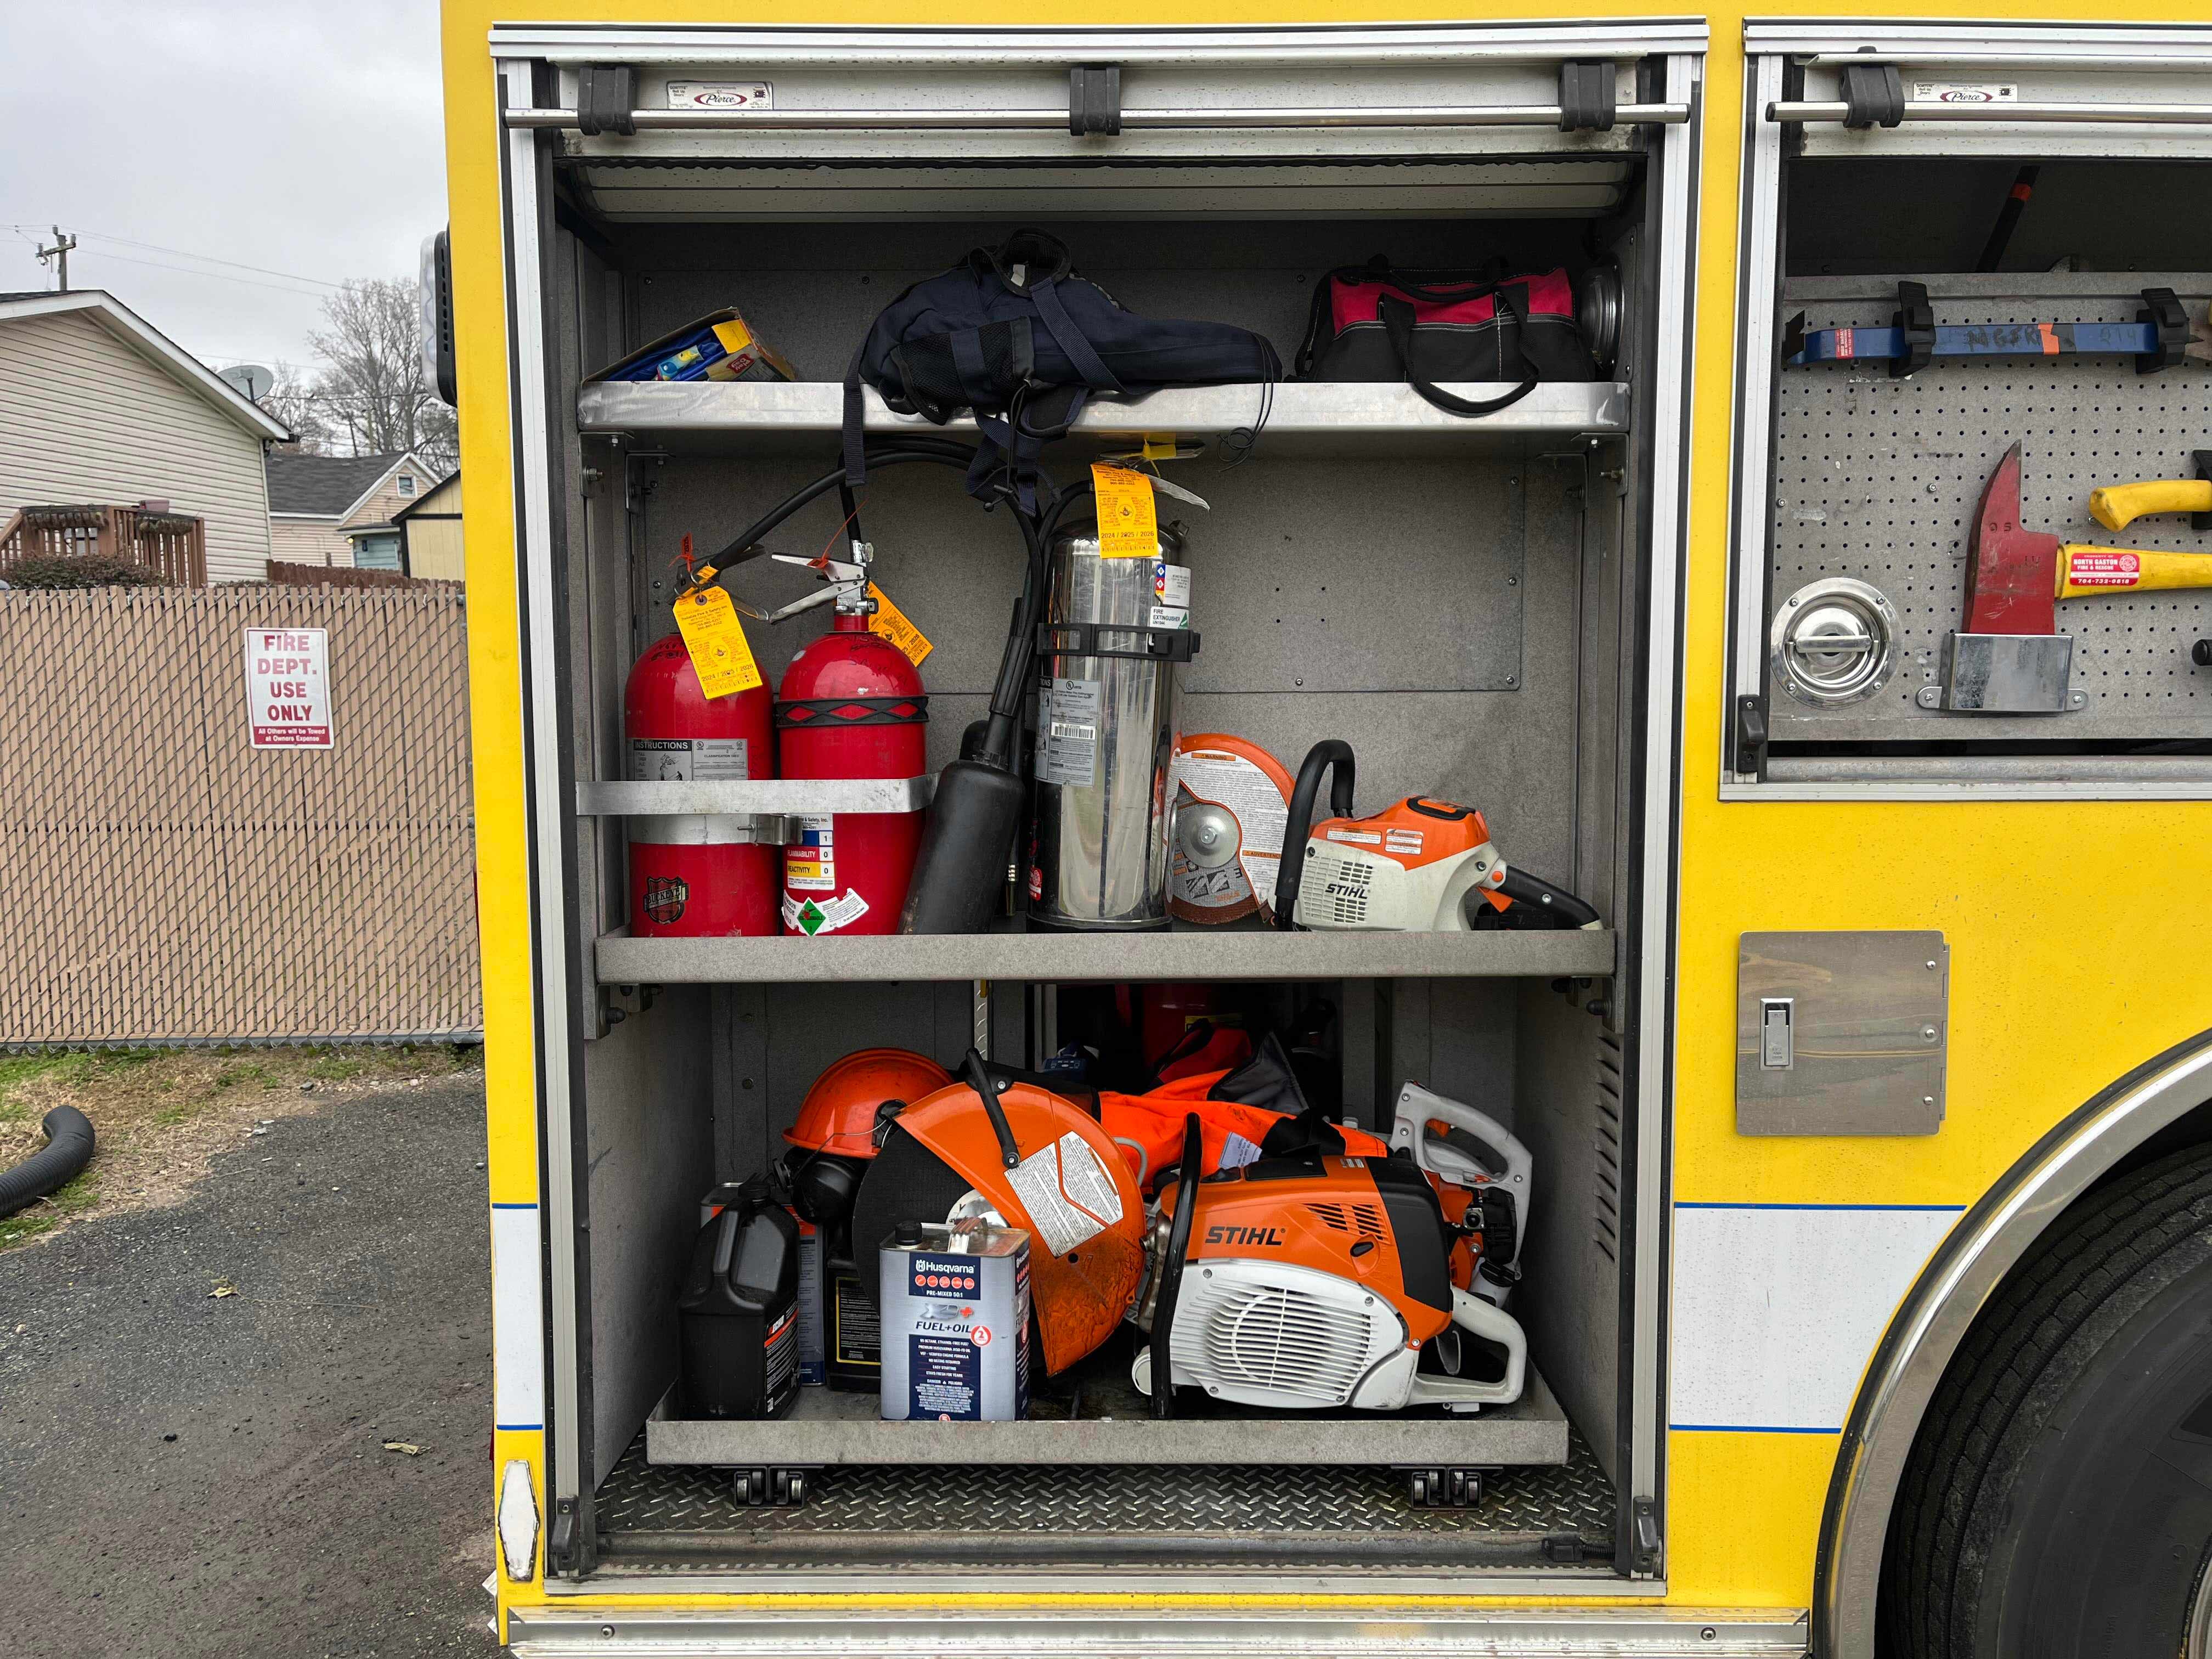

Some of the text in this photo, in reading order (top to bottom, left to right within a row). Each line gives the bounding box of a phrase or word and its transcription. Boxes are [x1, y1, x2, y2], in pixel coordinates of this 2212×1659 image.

[706, 93, 735, 104] Pierce
[1951, 92, 1980, 102] Pierce
[264, 635, 310, 651] FIRE
[909, 634, 920, 646] 2026
[257, 658, 317, 675] DEPT.
[270, 681, 307, 698] USE
[267, 704, 312, 721] ONLY
[635, 741, 689, 749] INSTRUCTIONS
[788, 865, 810, 873] REACTIVITY
[647, 887, 681, 905] BUCKEYE
[1325, 883, 1368, 899] STIHL
[1205, 1226, 1282, 1246] STIHL
[926, 1262, 974, 1274] Husqvarna
[916, 1321, 971, 1333] FUEL+OIL
[978, 1330, 984, 1339] 2
